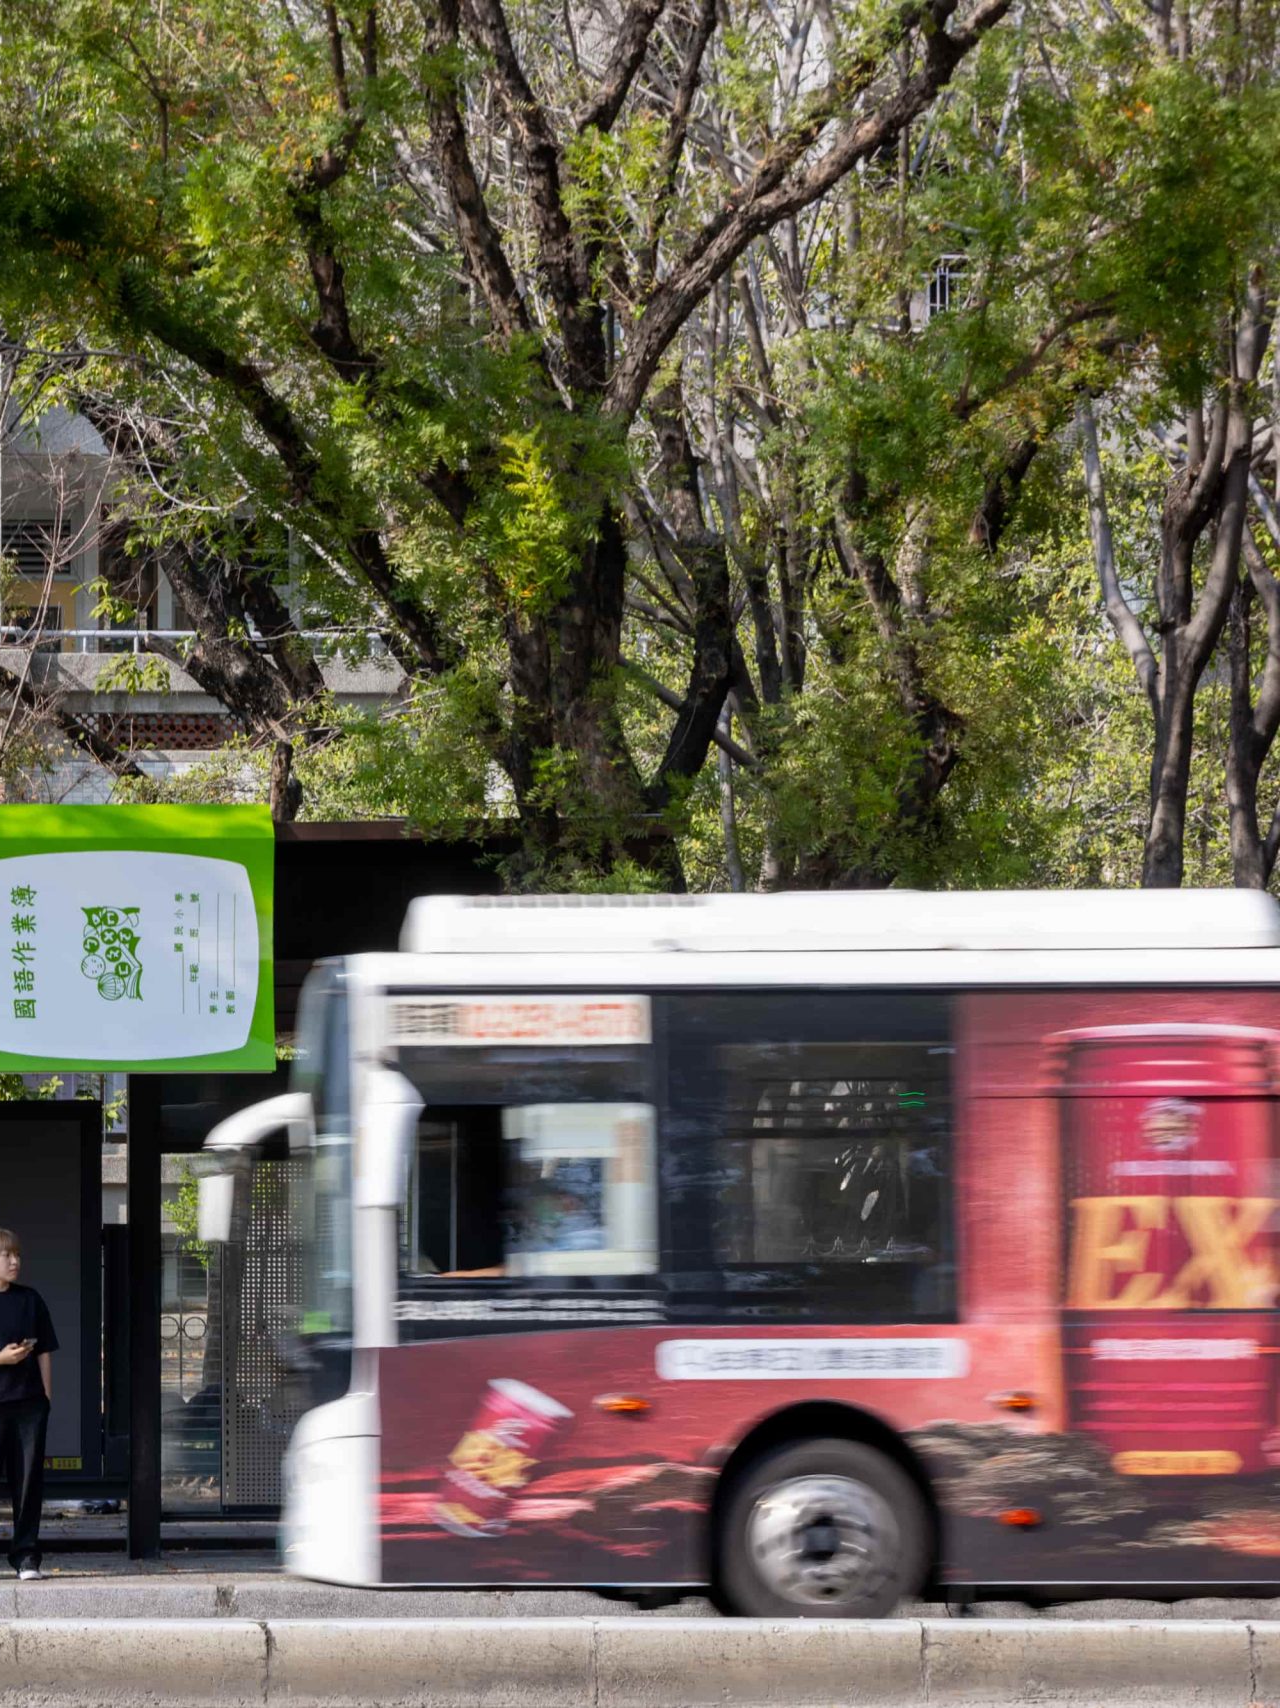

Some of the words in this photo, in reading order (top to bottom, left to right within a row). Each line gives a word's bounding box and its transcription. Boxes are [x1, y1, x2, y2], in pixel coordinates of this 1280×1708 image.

[173, 892, 184, 953] 國民小學
[10, 884, 38, 1019] 國語作業簿
[189, 963, 199, 983] 年級
[209, 990, 219, 1014] 學生
[225, 990, 236, 1015] 教師
